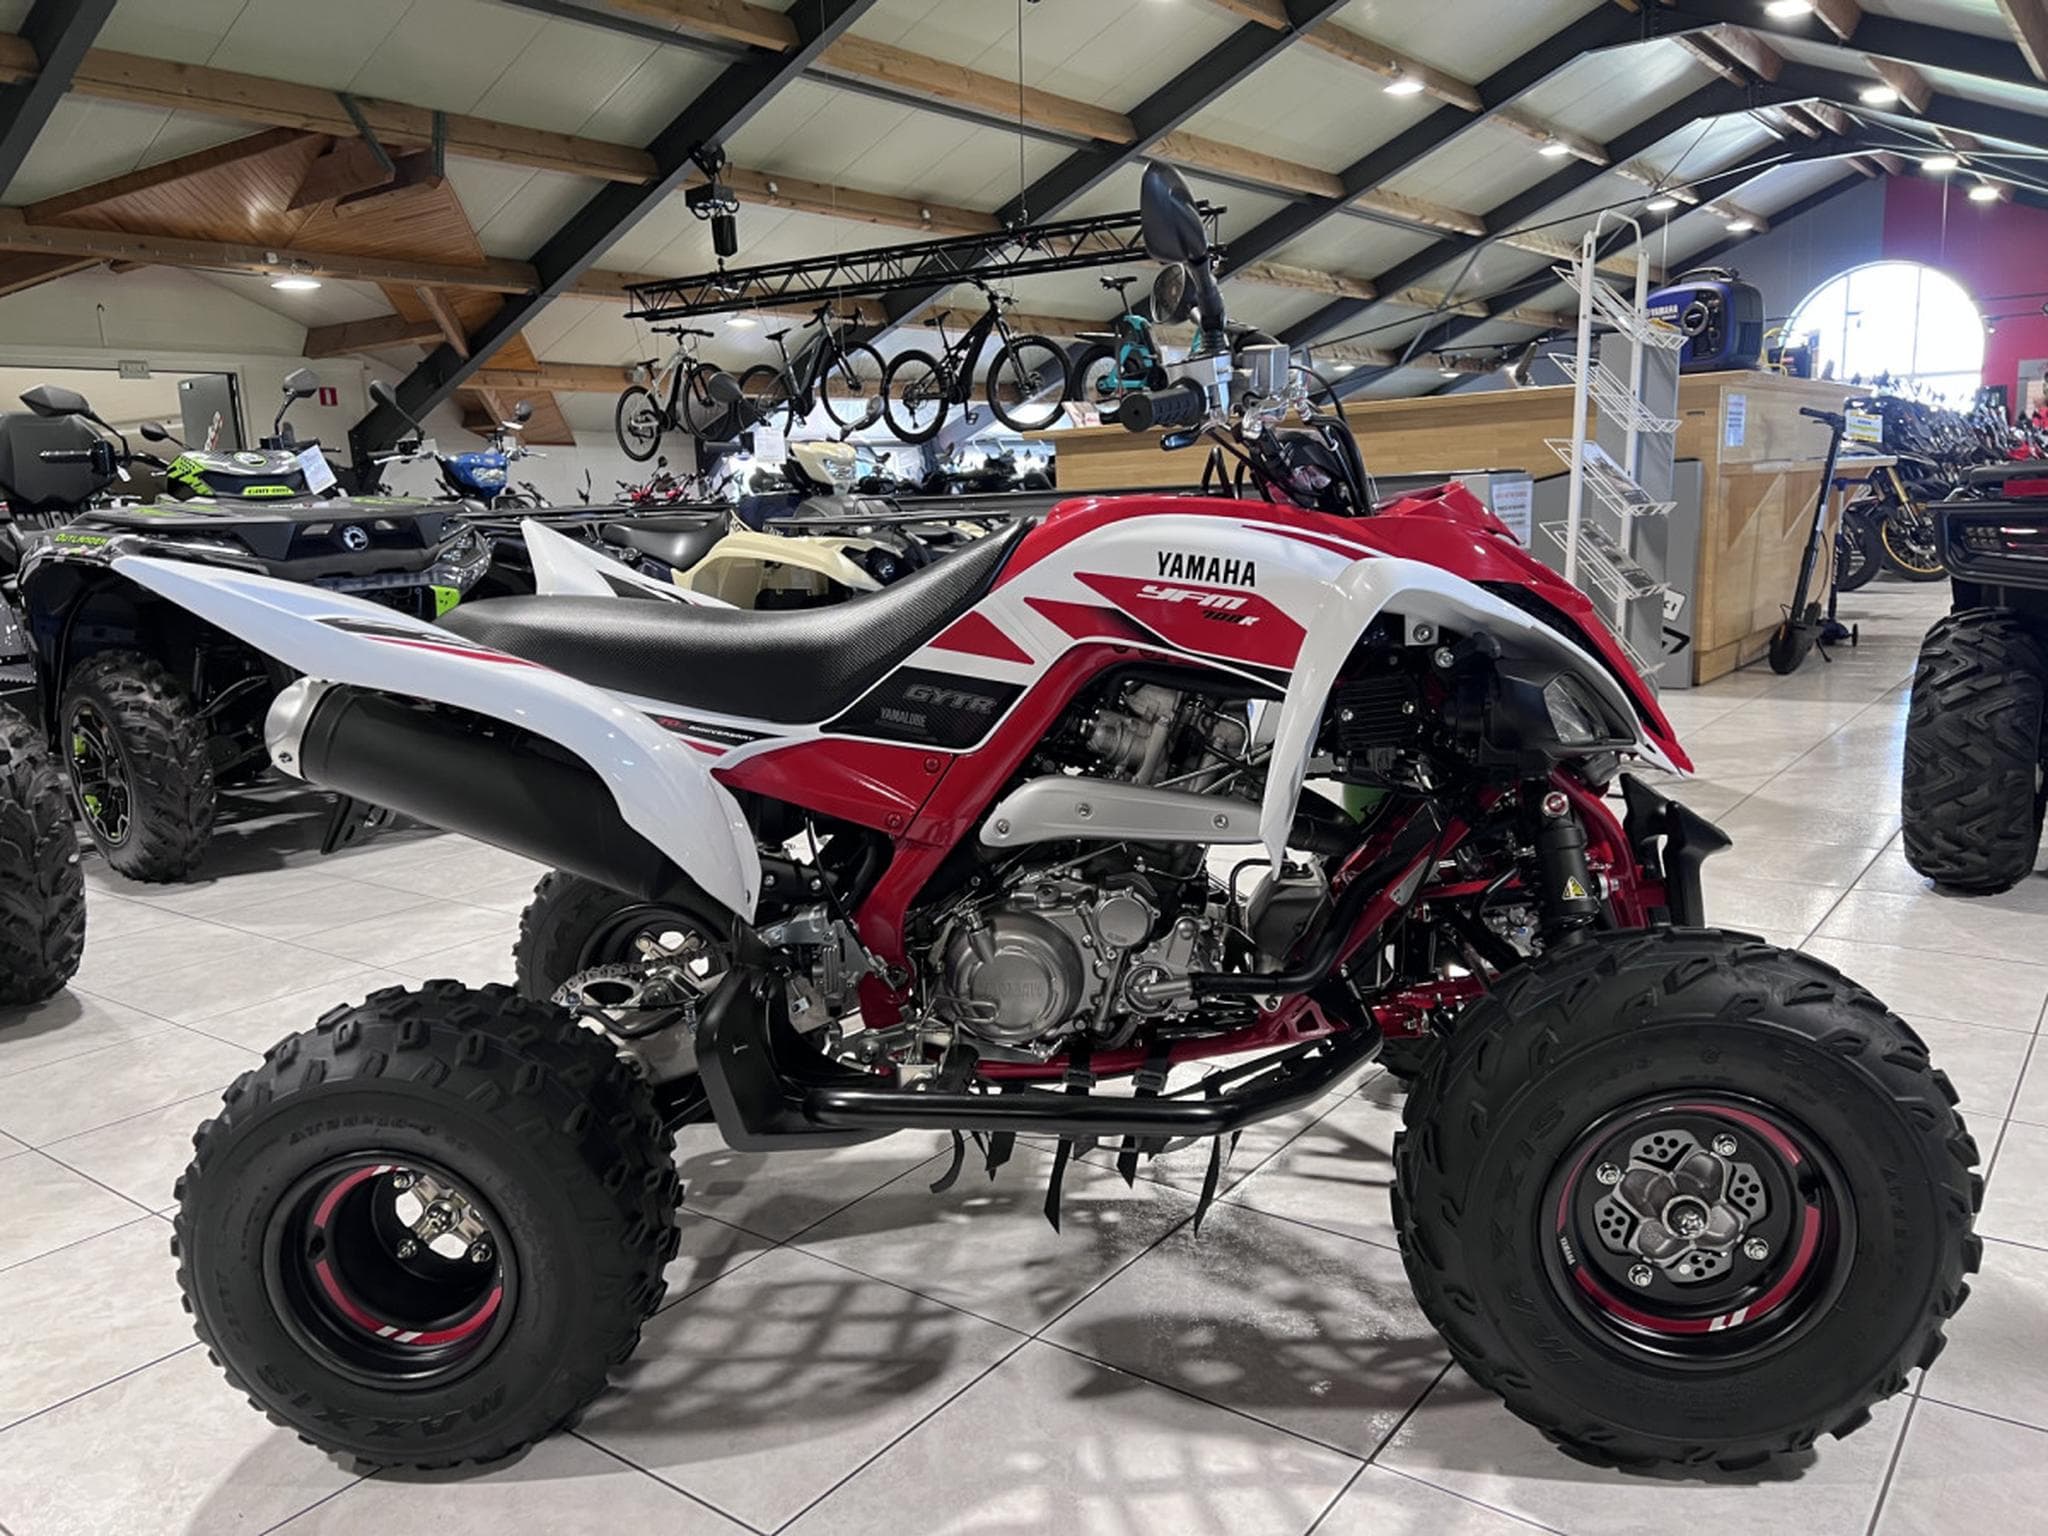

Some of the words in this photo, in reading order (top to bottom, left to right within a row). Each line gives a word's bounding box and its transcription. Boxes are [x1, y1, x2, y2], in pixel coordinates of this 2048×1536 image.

[1157, 551, 1255, 588] YAMAHA
[1136, 585, 1249, 610] YFM
[903, 683, 997, 714] GYTR
[881, 707, 927, 727] YAMALUBE
[256, 1364, 507, 1438] MAXXIS
